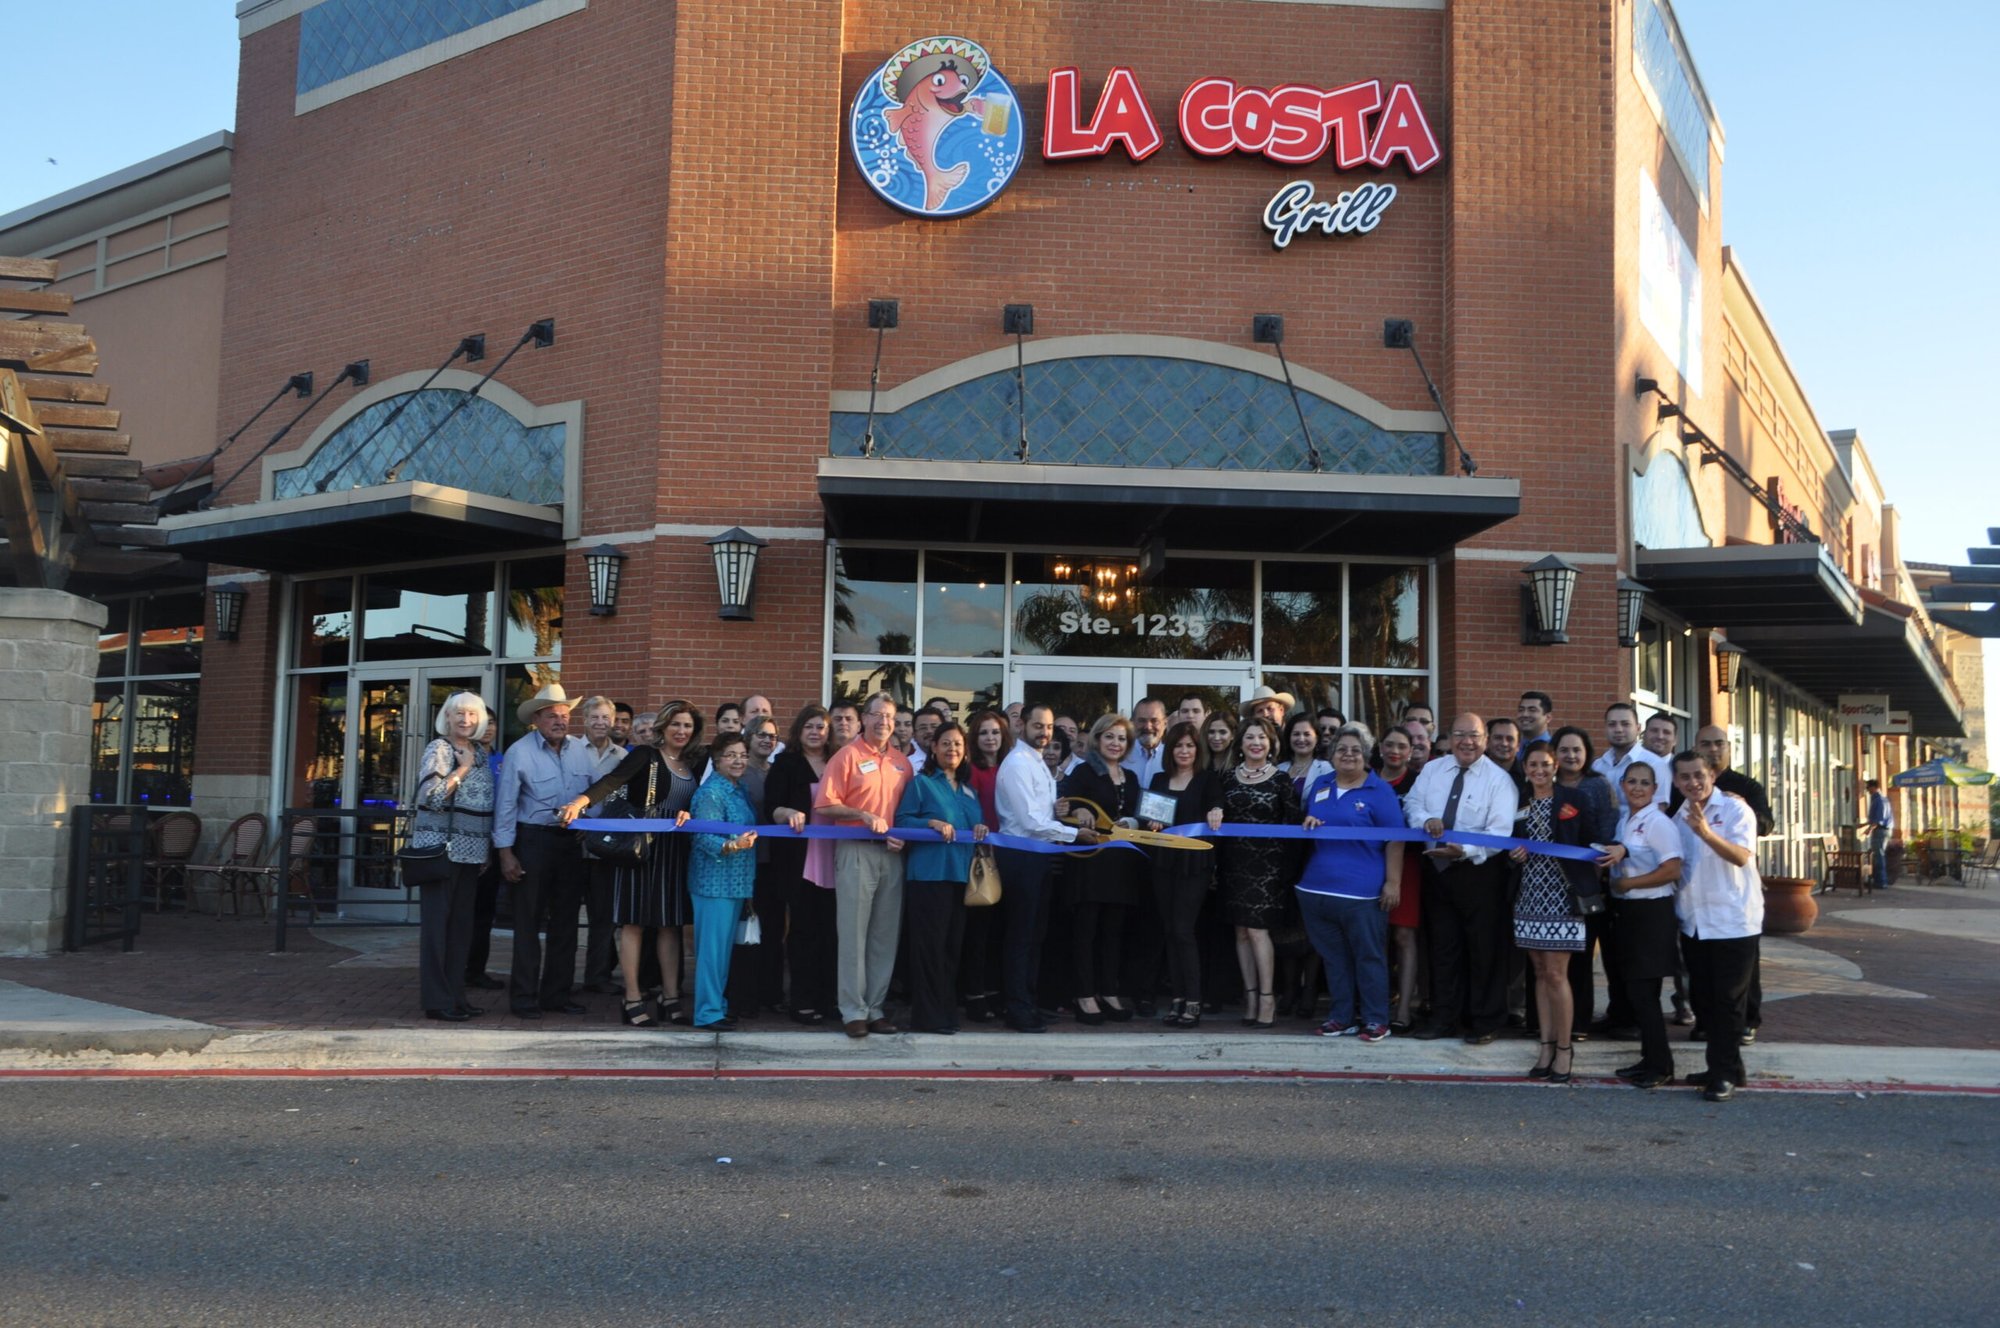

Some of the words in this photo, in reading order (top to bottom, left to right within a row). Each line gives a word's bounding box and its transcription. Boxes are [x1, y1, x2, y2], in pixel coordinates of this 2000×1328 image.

[1043, 66, 1164, 161] LA
[1179, 76, 1442, 174] COSTA
[1264, 180, 1397, 248] Grill
[1059, 611, 1120, 635] Ste.
[1131, 613, 1206, 637] 1235
